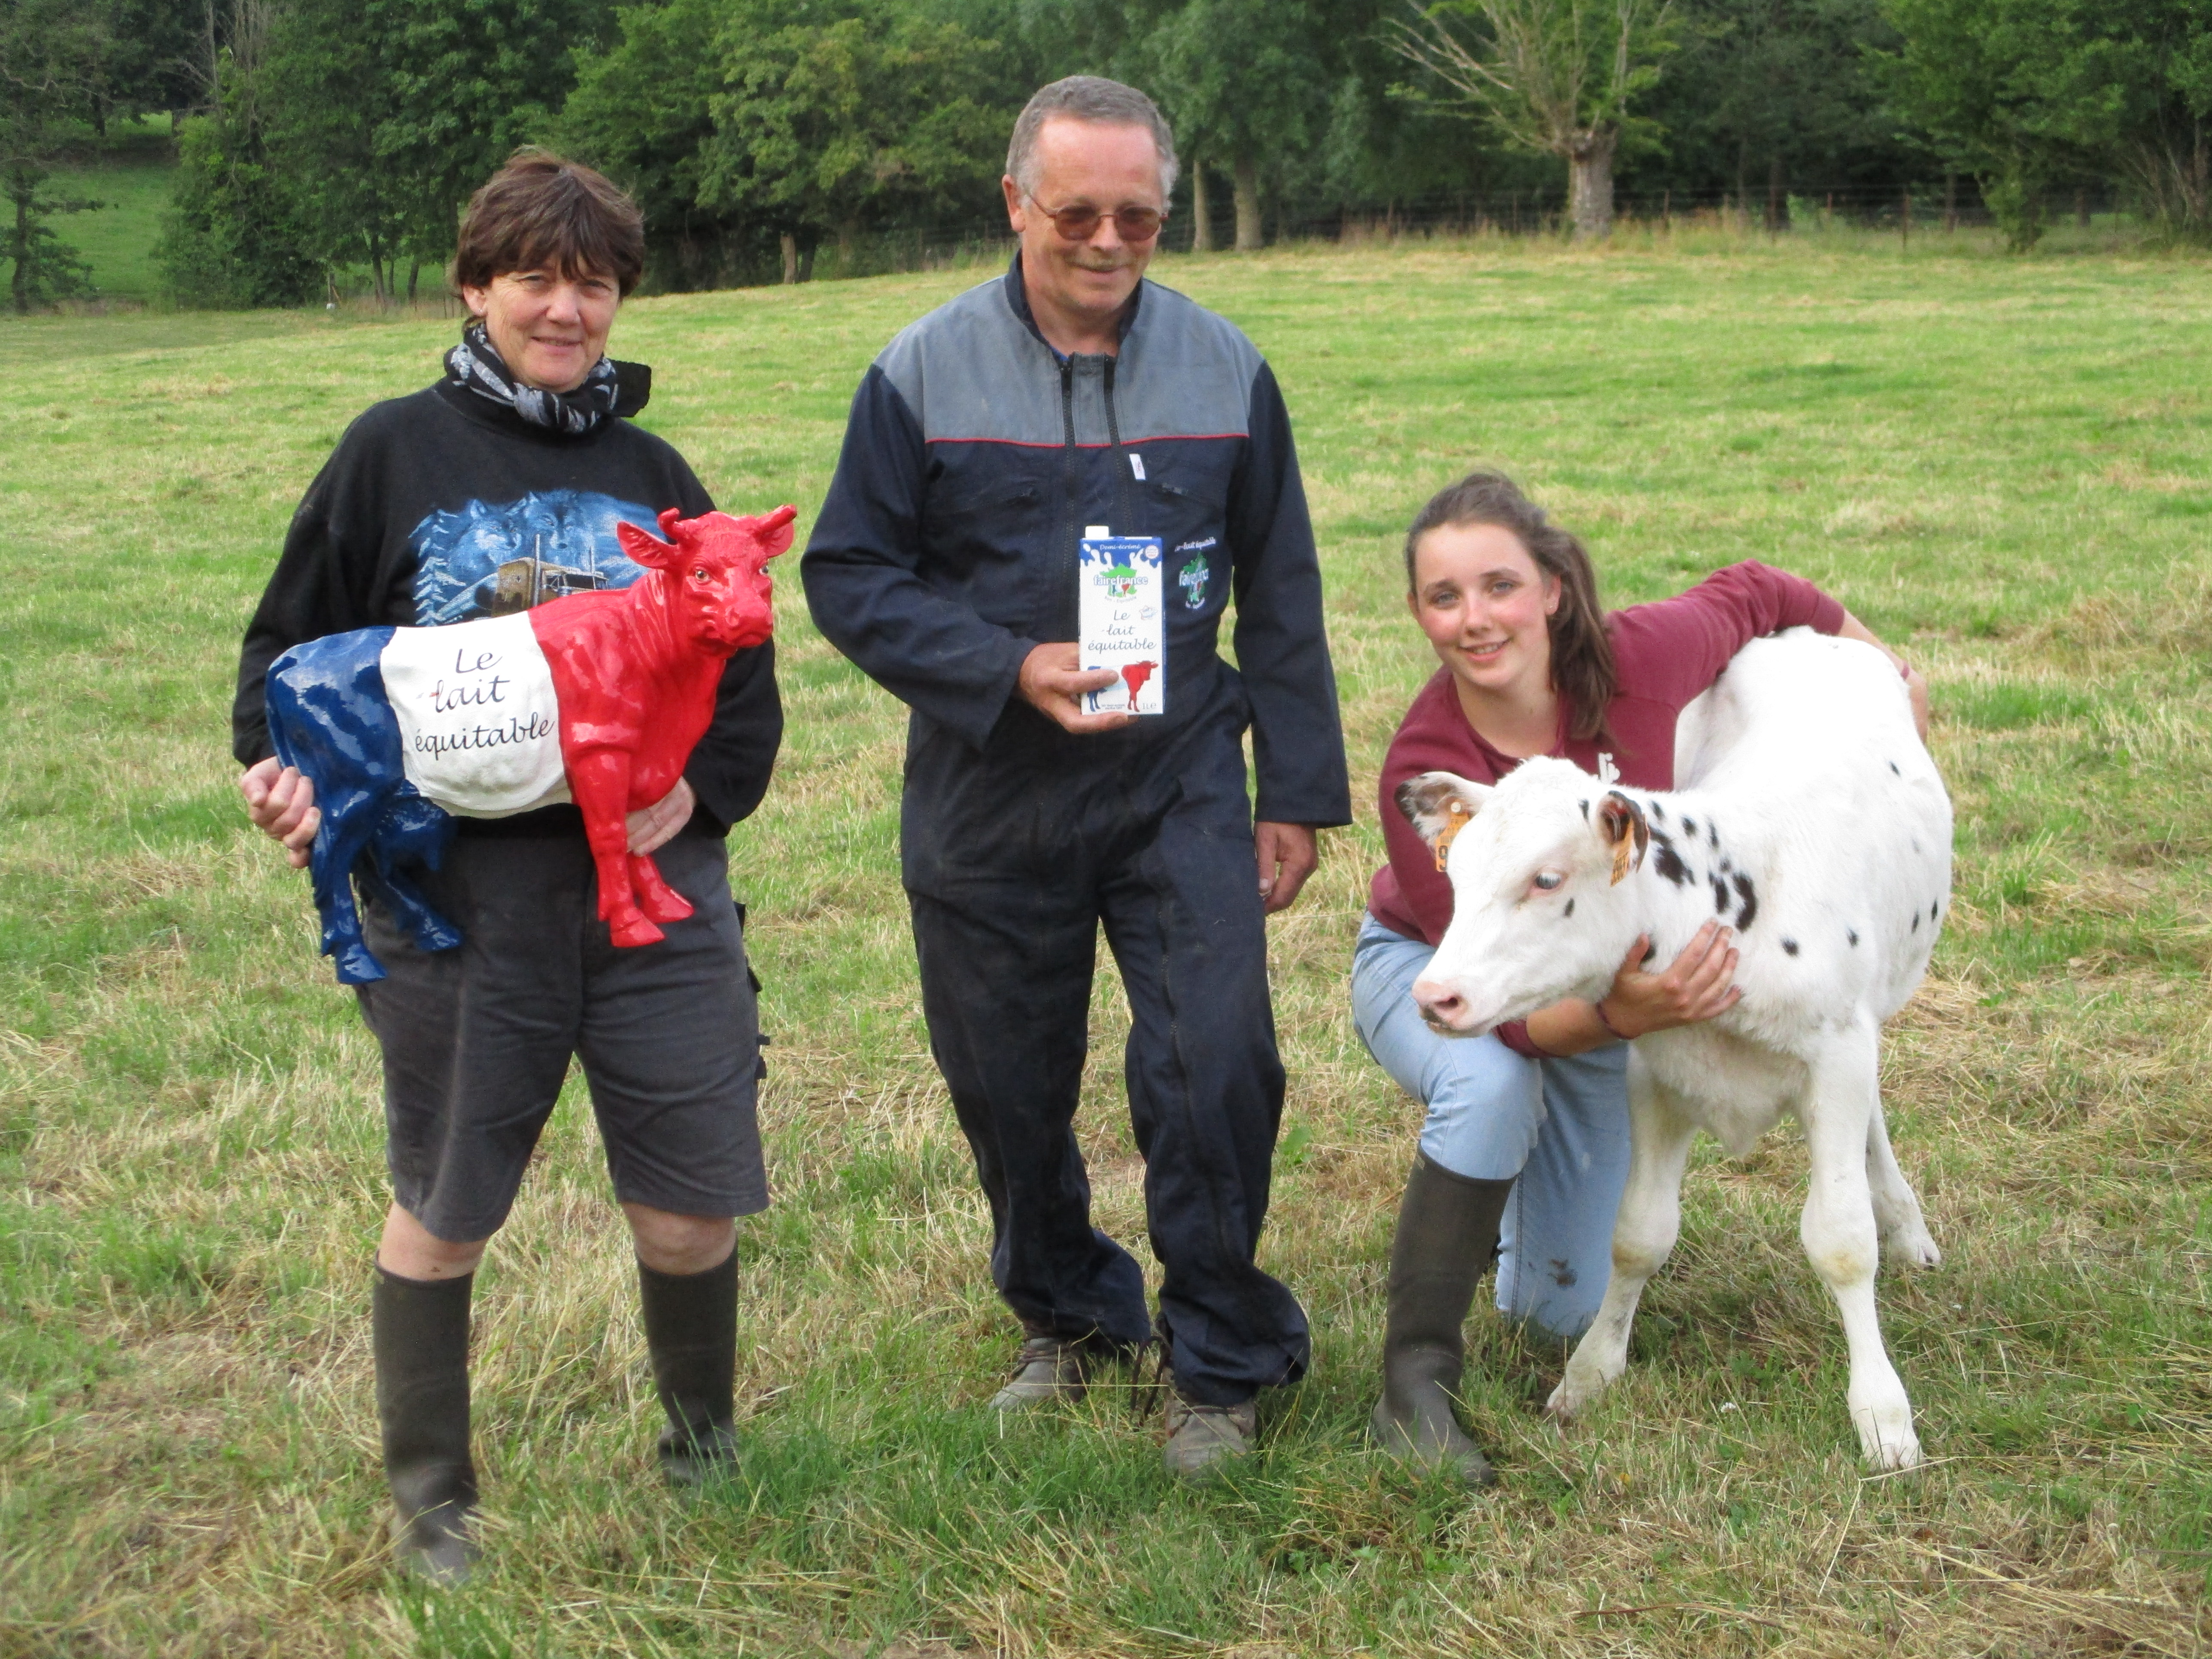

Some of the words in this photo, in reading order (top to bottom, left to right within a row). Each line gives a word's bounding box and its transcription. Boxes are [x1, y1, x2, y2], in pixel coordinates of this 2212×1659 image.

[1093, 574, 1149, 586] fairefrance
[1114, 610, 1131, 620] Le
[1108, 624, 1136, 635] lait
[1088, 638, 1157, 654] équitable
[456, 648, 503, 674] Le
[435, 675, 511, 713] lait
[415, 712, 556, 761] équitable
